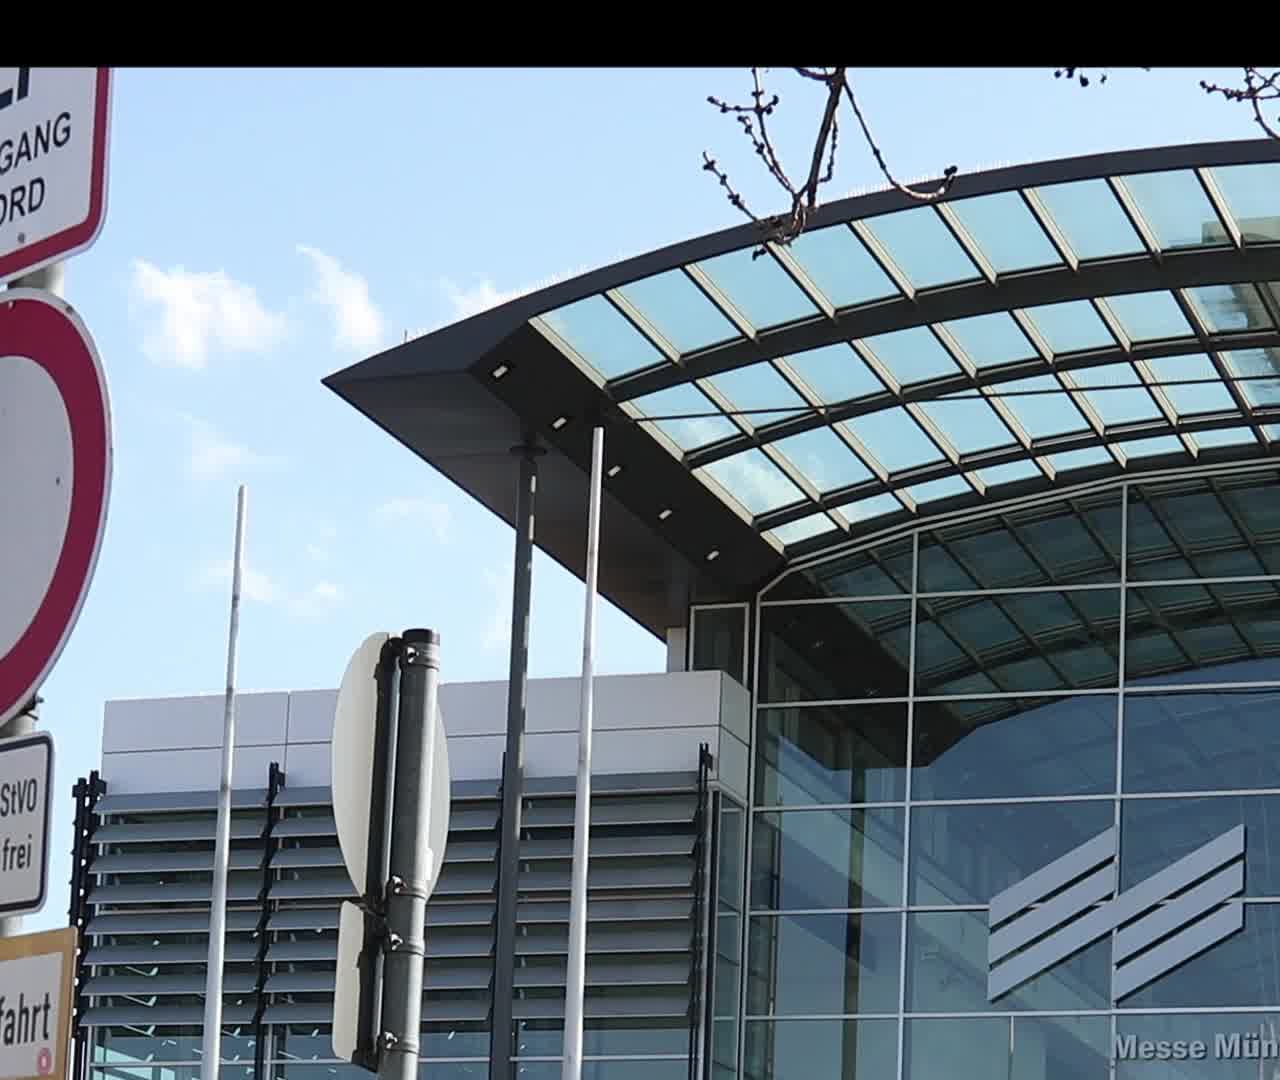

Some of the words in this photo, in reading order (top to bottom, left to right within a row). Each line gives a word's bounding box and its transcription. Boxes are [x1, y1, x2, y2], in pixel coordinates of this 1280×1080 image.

[0, 778, 37, 818] StVO
[2, 834, 32, 872] frei
[1112, 1033, 1207, 1060] Messe
